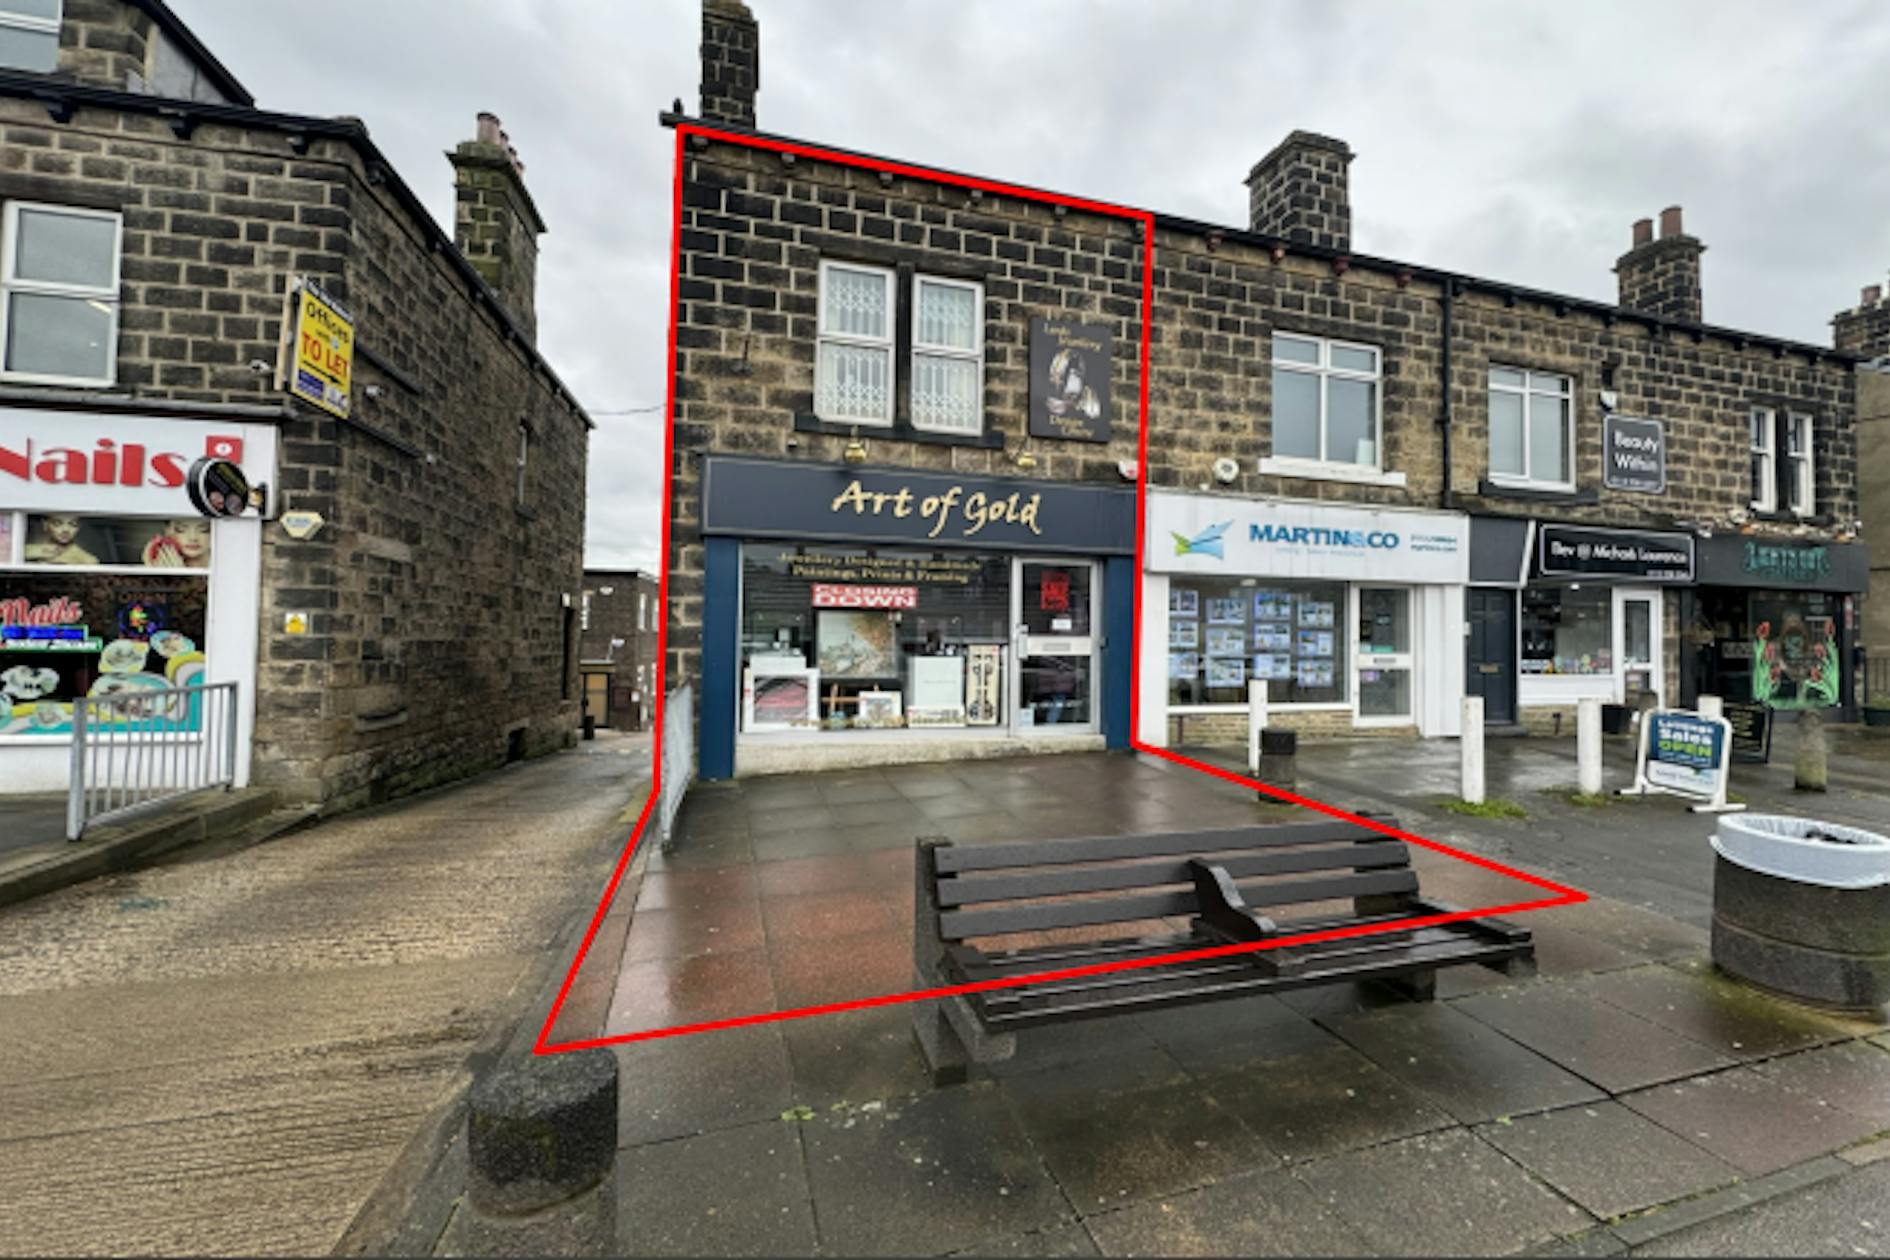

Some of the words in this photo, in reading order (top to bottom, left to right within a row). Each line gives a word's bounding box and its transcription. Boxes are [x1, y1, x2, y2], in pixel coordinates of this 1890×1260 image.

[302, 331, 322, 361] TO
[325, 349, 348, 379] LET
[1615, 430, 1661, 454] Beauty
[1615, 452, 1658, 473] Within
[831, 480, 914, 517] Art
[919, 486, 963, 539] of
[963, 491, 1042, 536] Gold
[814, 584, 918, 598] CLOSING
[813, 595, 918, 608] DOWN
[1658, 728, 1713, 746] Sales
[1658, 740, 1713, 758] OPEN
